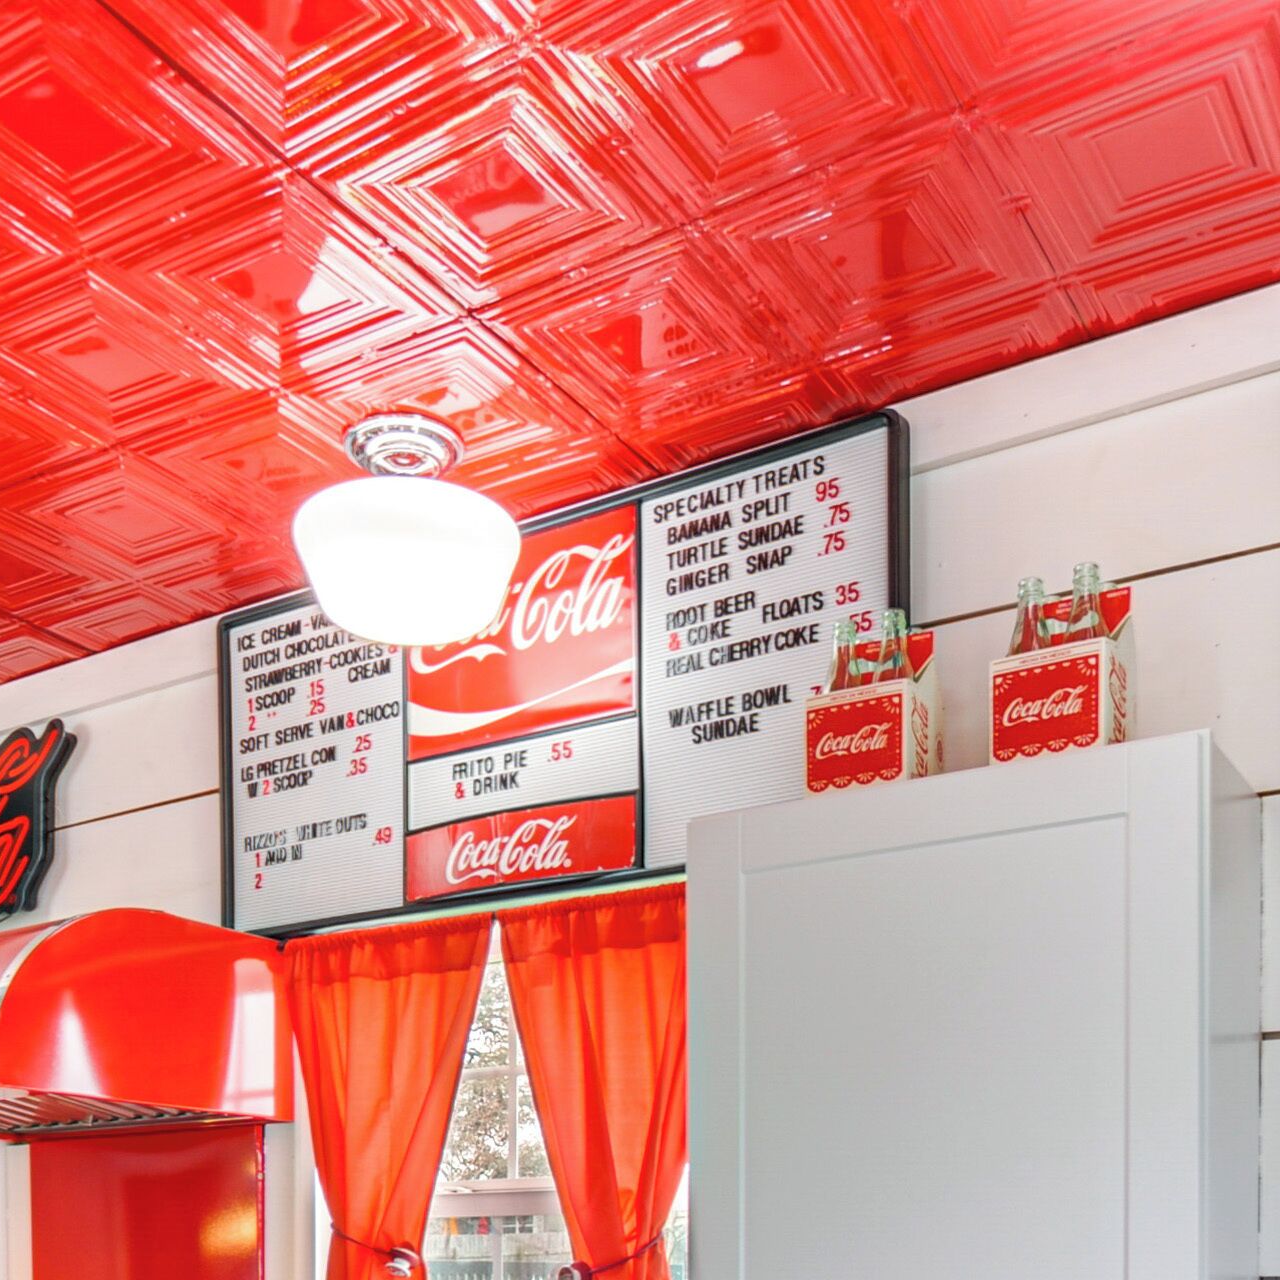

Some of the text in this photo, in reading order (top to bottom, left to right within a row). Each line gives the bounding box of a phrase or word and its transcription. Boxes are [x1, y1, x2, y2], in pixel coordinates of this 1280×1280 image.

[653, 455, 826, 524] SPECIALTY TREATS
[667, 477, 840, 546] BANANA SPLIT 95
[666, 501, 851, 571] TURTLE SUNDAE .75
[666, 530, 846, 597] GINGER SNAP .75
[666, 581, 860, 631] ROOT BEER FLOATS 35
[238, 633, 256, 652] ICE
[261, 619, 302, 645] CREAM
[665, 650, 704, 679] REAL
[709, 634, 770, 667] CHERRY
[774, 623, 820, 651] COKE
[668, 618, 731, 651] & COKE
[243, 647, 280, 672] DUTCH
[348, 658, 391, 683] CREAM
[248, 715, 256, 731] 2
[669, 695, 734, 729] WAFFLE
[742, 683, 792, 712] BOWL
[1002, 684, 1089, 727] Coca-Cola
[240, 733, 269, 754] SOFT
[275, 722, 314, 746] SERVE
[691, 712, 760, 745] SUNDAE
[815, 722, 893, 760] Coca-Cola
[241, 766, 253, 782] LG
[257, 753, 307, 778] PRETZEL
[311, 745, 337, 766] CON
[452, 740, 573, 781] FRITO PIE .55
[248, 782, 257, 799] W
[262, 779, 271, 795] 2
[273, 770, 313, 794] SCOOP
[454, 774, 521, 799] & DRINK
[296, 818, 333, 842] WHITE
[335, 812, 367, 834] OUTS
[255, 852, 262, 868] 1
[445, 814, 578, 885] Coca-Cola
[254, 873, 263, 890] 2
